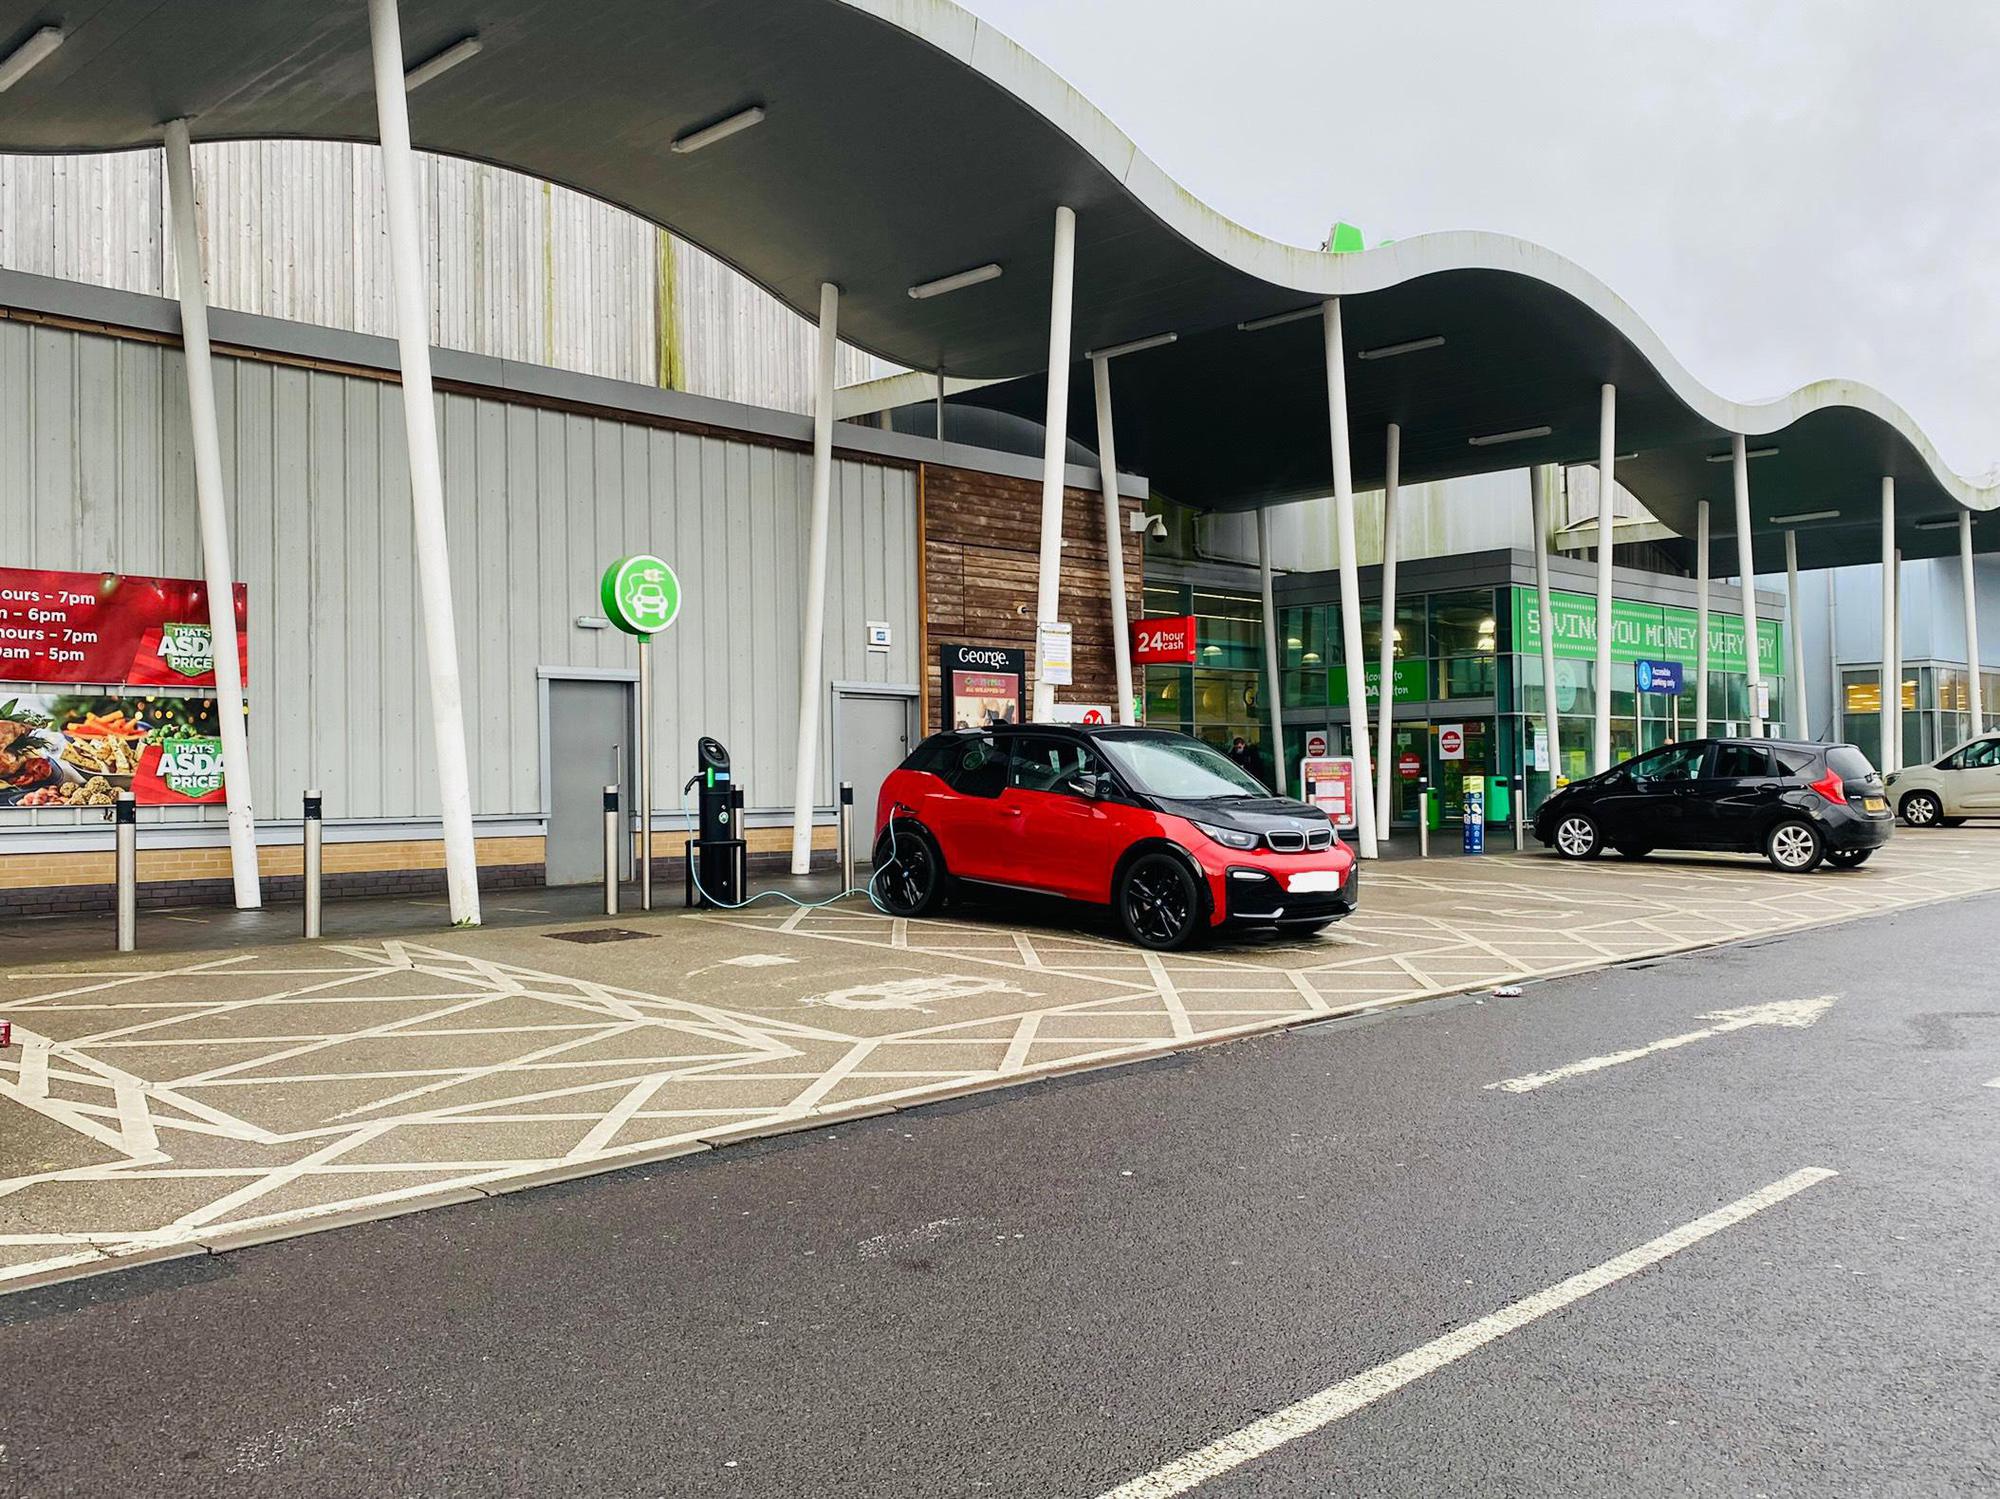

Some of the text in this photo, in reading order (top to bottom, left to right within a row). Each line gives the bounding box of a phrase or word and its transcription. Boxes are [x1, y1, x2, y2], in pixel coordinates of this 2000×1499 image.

[0, 589, 40, 602] ours
[58, 591, 96, 606] 7pm
[28, 608, 67, 624] 6pm
[63, 629, 98, 645] 7pm
[173, 627, 211, 638] THAT'S
[1528, 609, 1597, 640] SVIN
[1611, 620, 1640, 645] YOU
[1645, 624, 1697, 650] MONEY
[1706, 631, 1745, 655] VERY
[157, 635, 214, 657] ASD
[1138, 631, 1185, 652] 24 hour
[1163, 640, 1184, 650] cash
[0, 647, 30, 659] am
[49, 647, 85, 663] 5pm
[958, 647, 1009, 670] George.
[172, 658, 213, 669] PRICE
[175, 744, 215, 754] THAT'S
[155, 753, 225, 777] ASDA
[171, 776, 219, 788] PRICE
